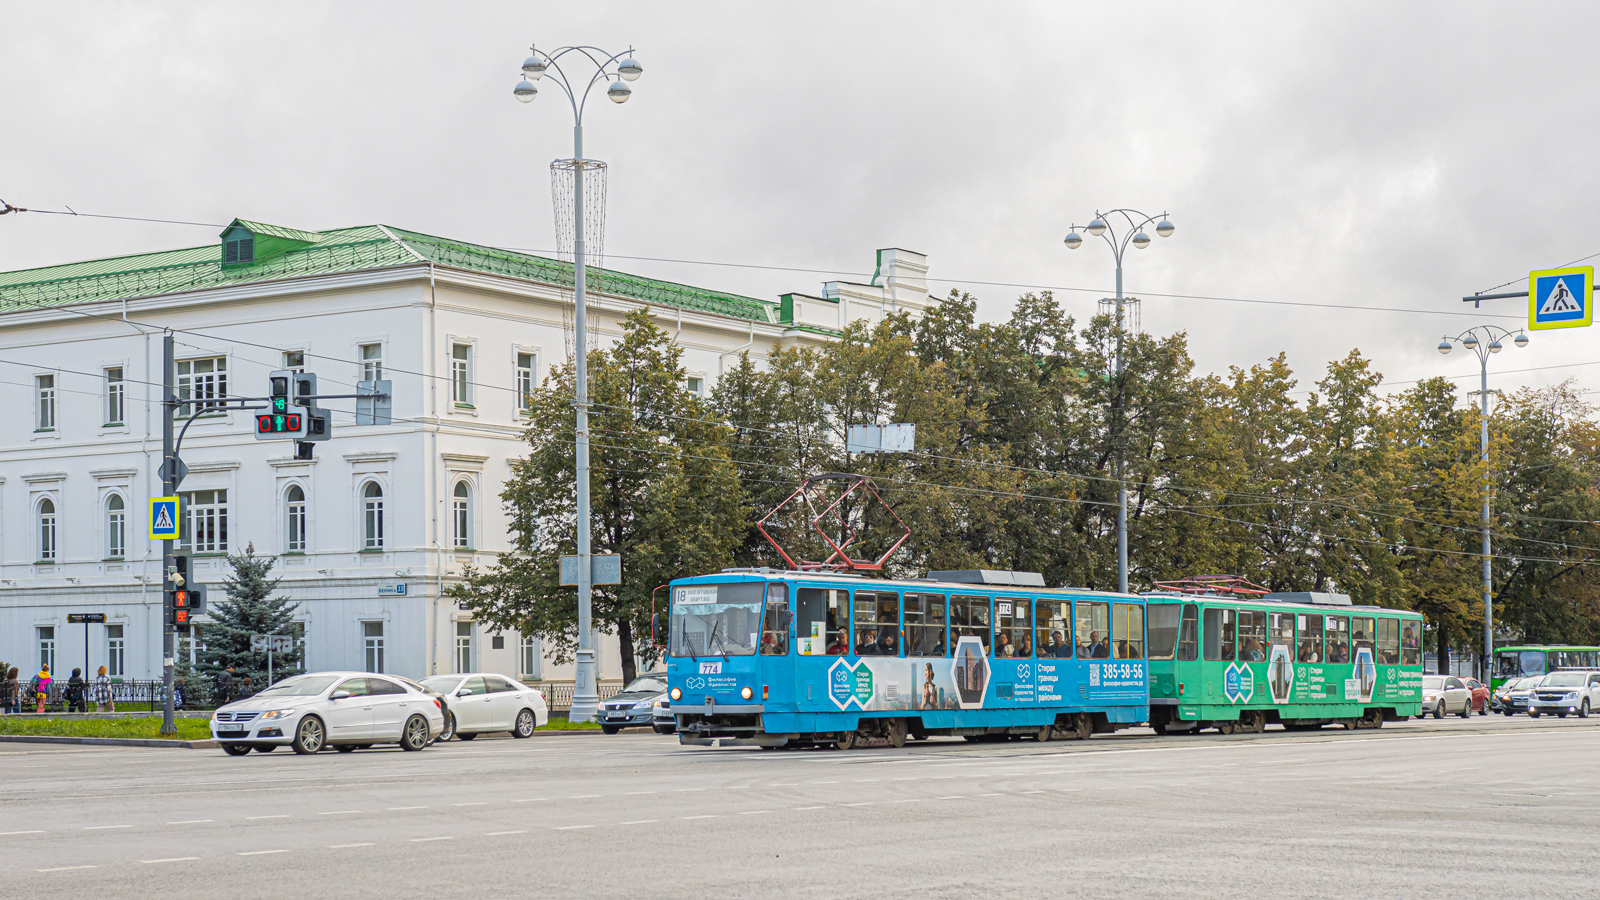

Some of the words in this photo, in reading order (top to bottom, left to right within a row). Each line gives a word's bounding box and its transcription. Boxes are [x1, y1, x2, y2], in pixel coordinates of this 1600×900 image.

[677, 590, 686, 602] 18
[1000, 604, 1010, 613] 774
[702, 665, 719, 674] 774
[1037, 664, 1056, 674] Стирая
[1102, 663, 1143, 679] 385-58-56
[1037, 675, 1059, 684] границы
[1037, 684, 1055, 693] между
